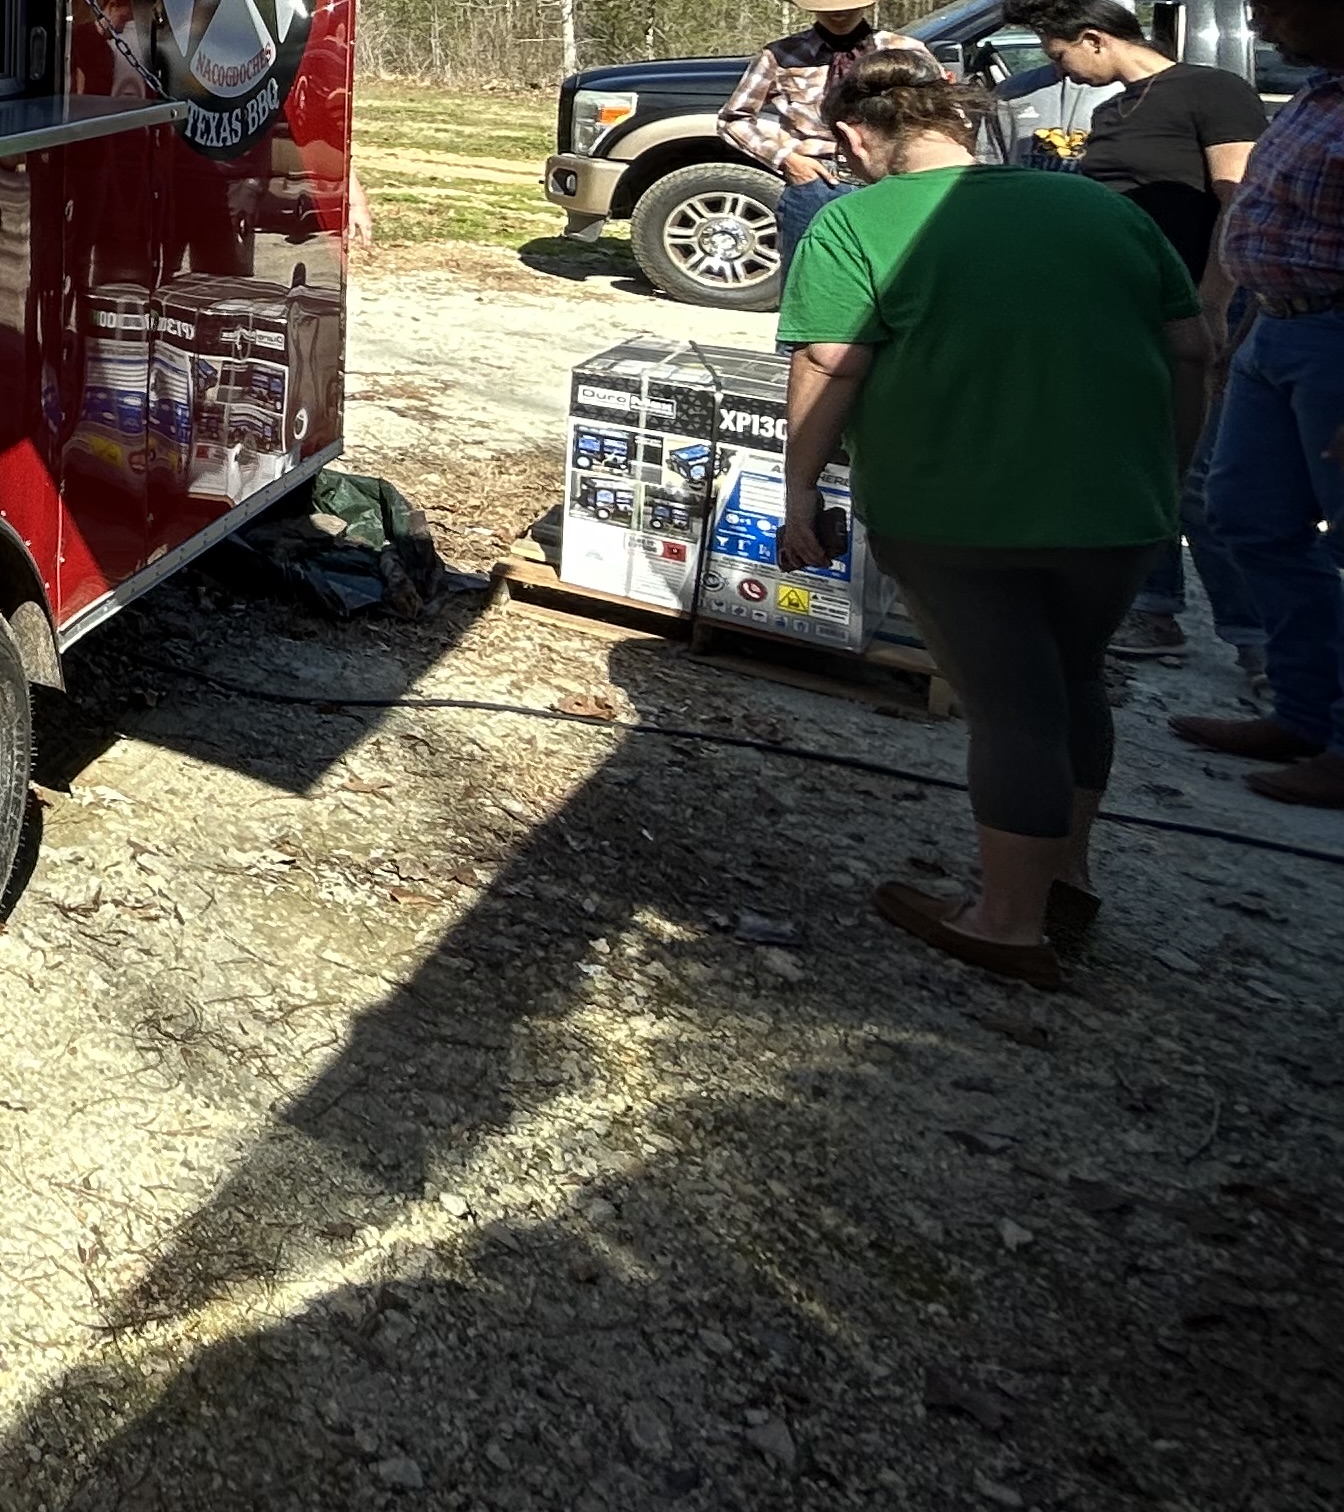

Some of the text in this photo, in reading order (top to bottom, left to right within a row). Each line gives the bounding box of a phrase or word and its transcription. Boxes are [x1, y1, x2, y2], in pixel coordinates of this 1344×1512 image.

[195, 41, 272, 88] NACOGDOCHES
[184, 78, 280, 148] TEXAS BBQ
[582, 388, 627, 403] Duro
